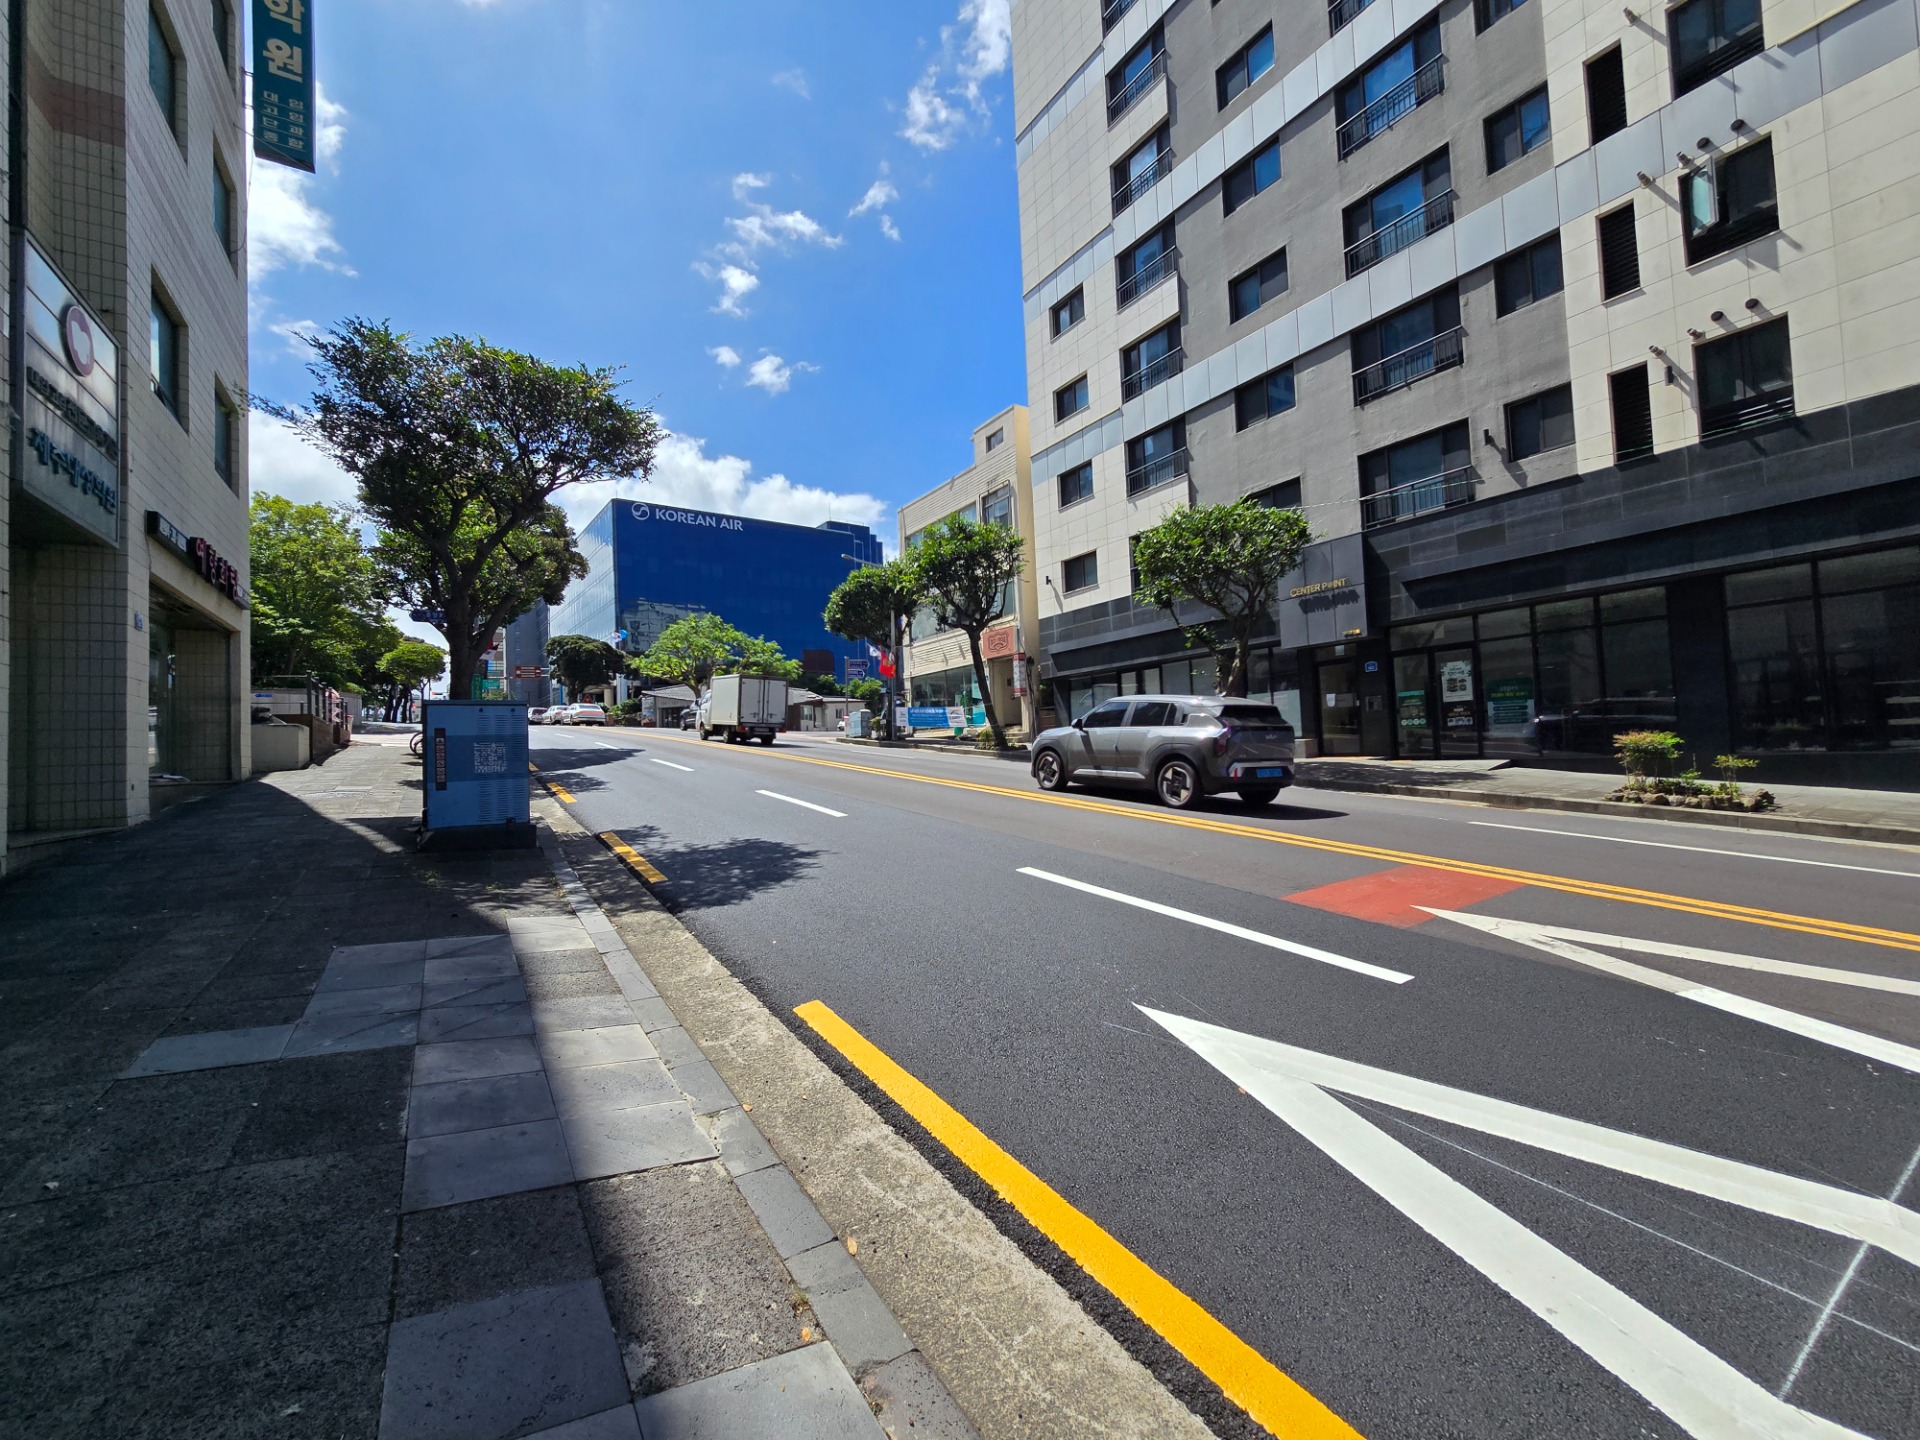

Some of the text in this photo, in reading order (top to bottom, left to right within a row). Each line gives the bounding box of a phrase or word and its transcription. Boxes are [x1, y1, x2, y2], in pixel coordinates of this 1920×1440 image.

[655, 508, 744, 531] KOREAN AIR
[1290, 577, 1349, 598] CENTER POINT
